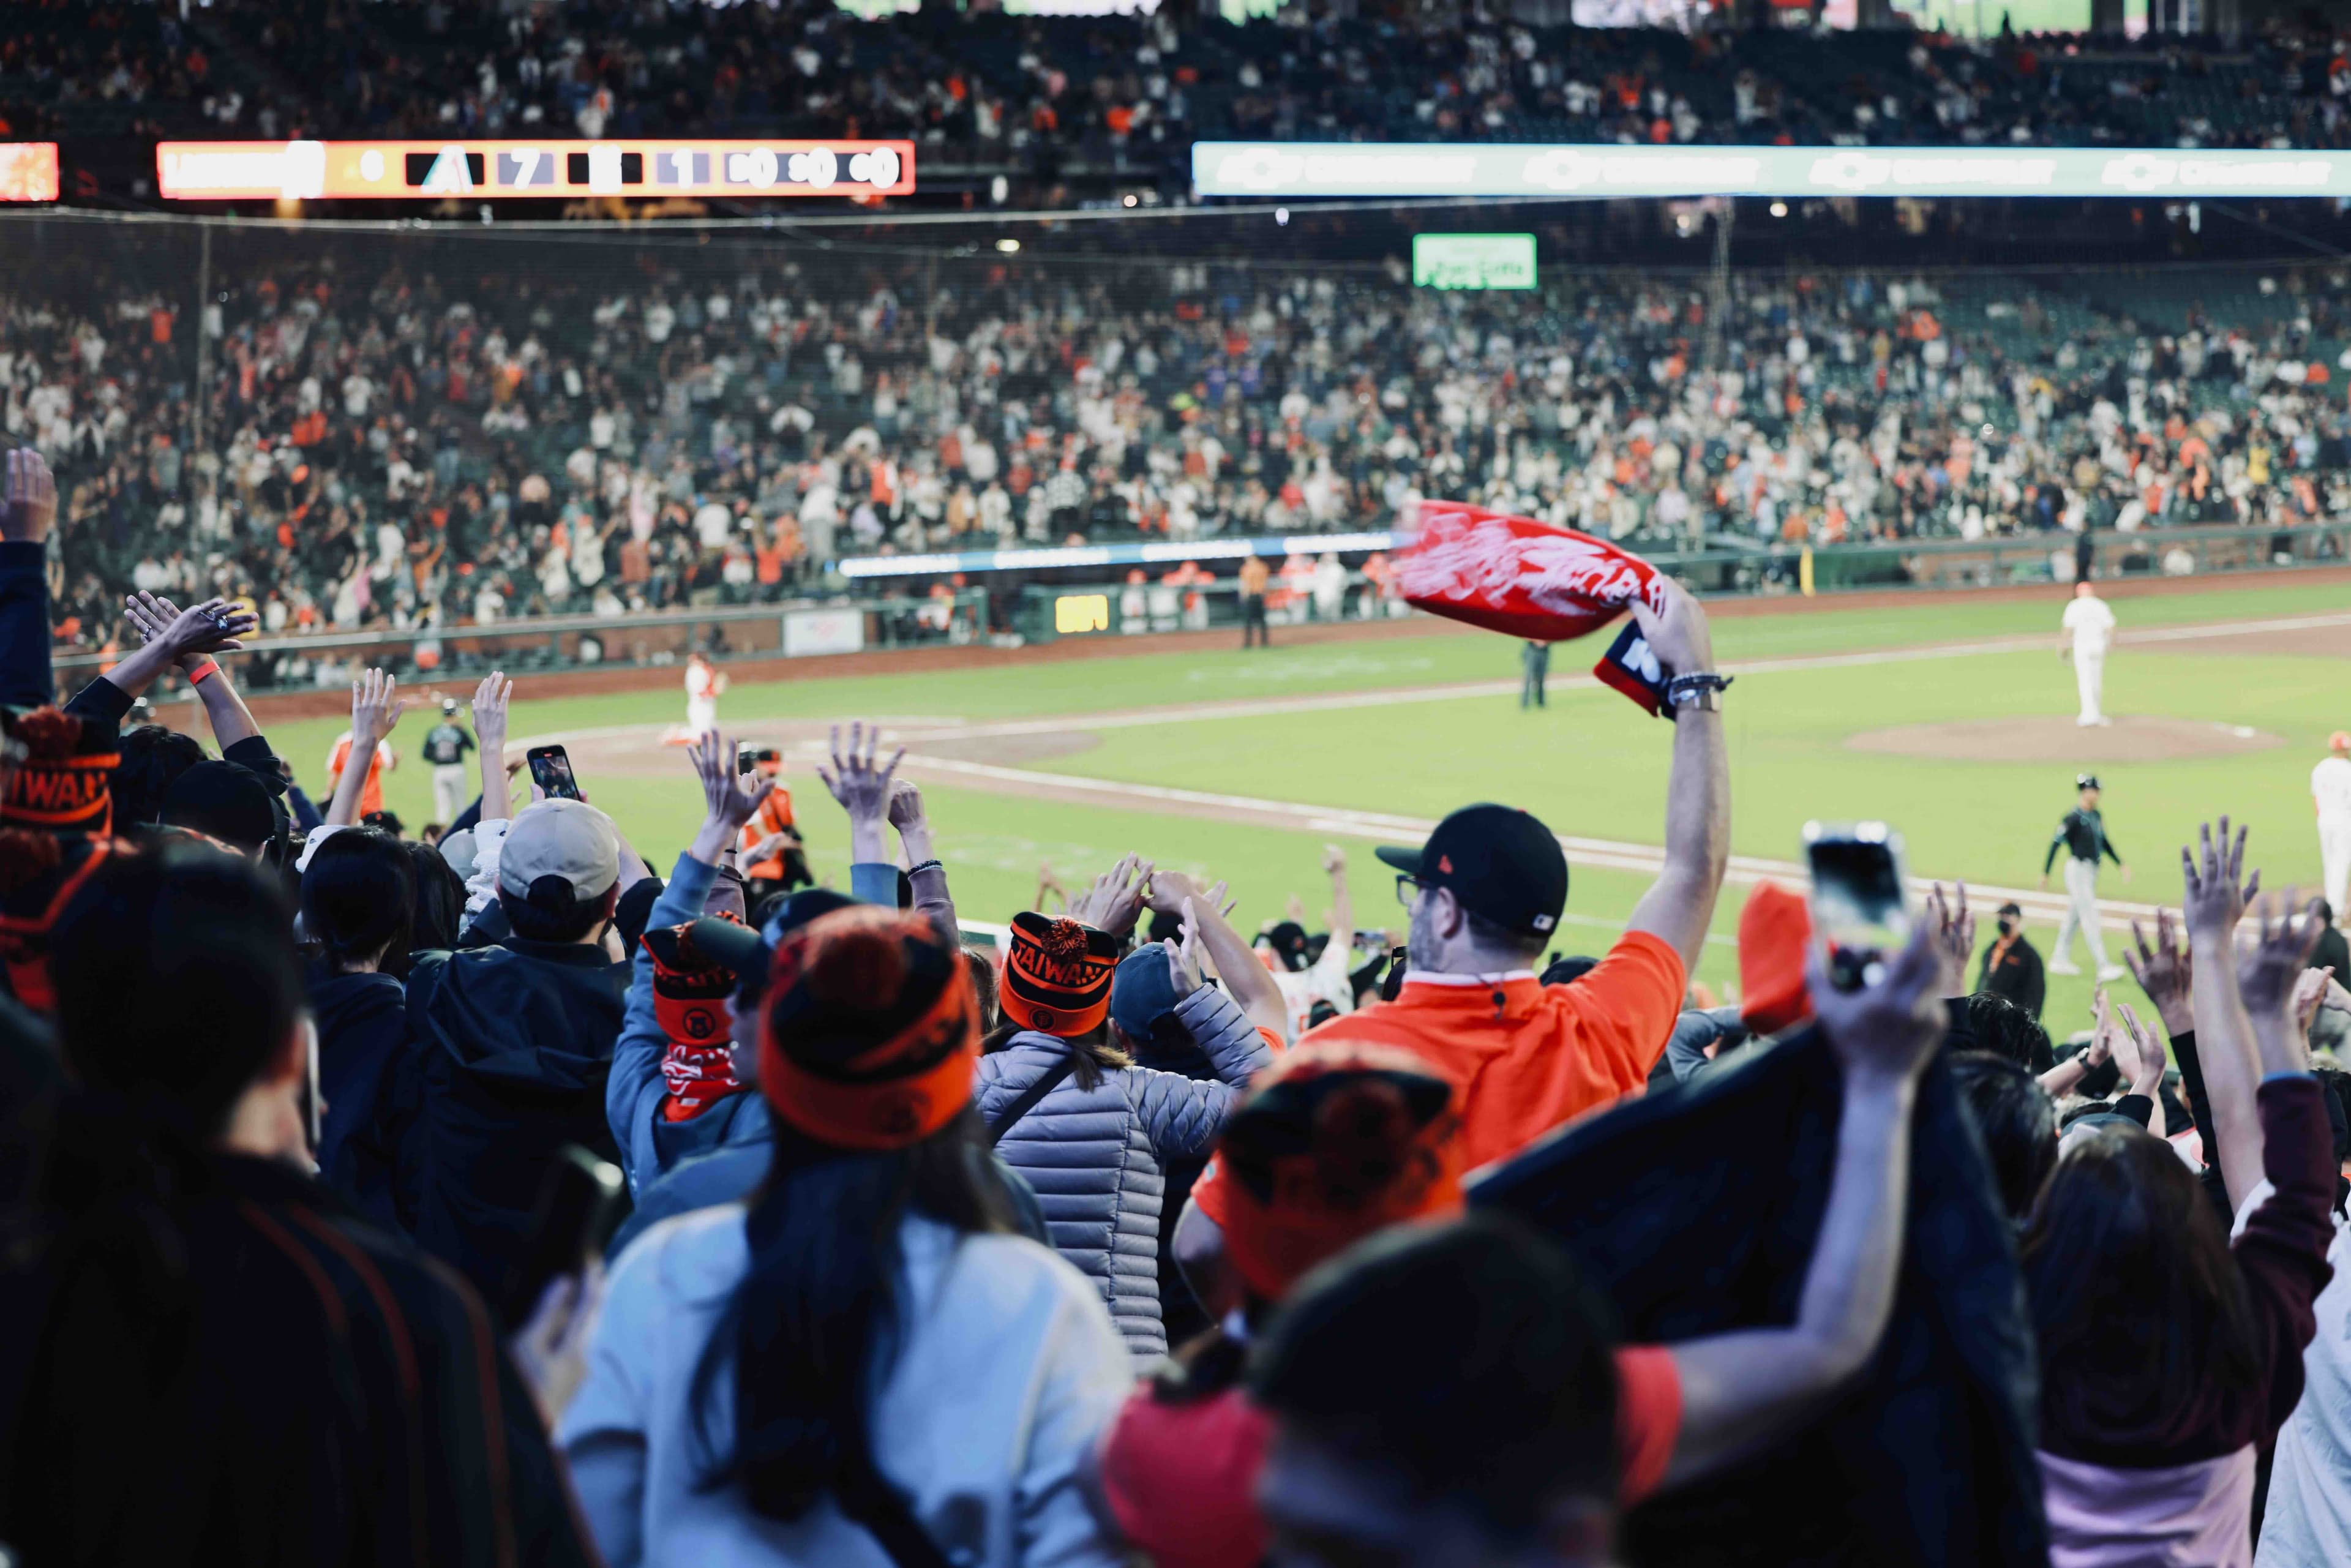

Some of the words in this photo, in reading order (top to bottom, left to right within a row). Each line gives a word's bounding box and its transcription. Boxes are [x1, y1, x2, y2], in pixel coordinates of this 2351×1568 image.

[511, 148, 540, 190] 7
[671, 147, 693, 189] 1
[11, 769, 107, 808] IWAN
[1016, 939, 1101, 985] TAIWAN
